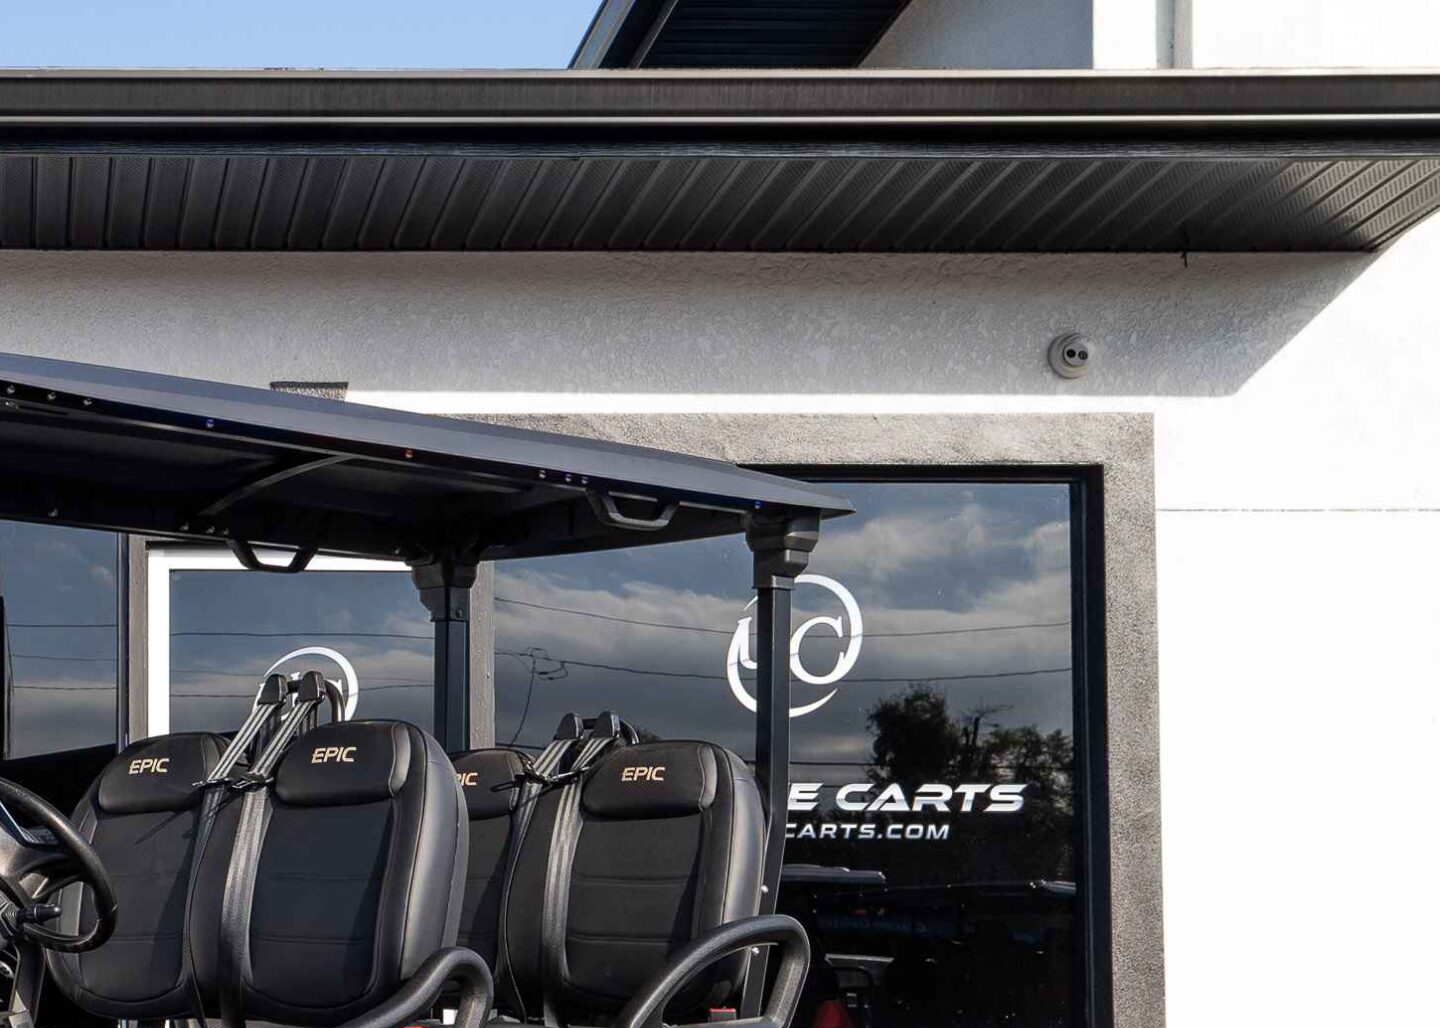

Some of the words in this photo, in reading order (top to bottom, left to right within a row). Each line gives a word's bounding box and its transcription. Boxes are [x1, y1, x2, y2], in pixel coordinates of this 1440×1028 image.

[310, 746, 357, 763] EPIC
[128, 758, 170, 774] EPIC
[621, 766, 666, 781] EPIC
[788, 783, 824, 811] E
[835, 783, 1028, 812] CARTS
